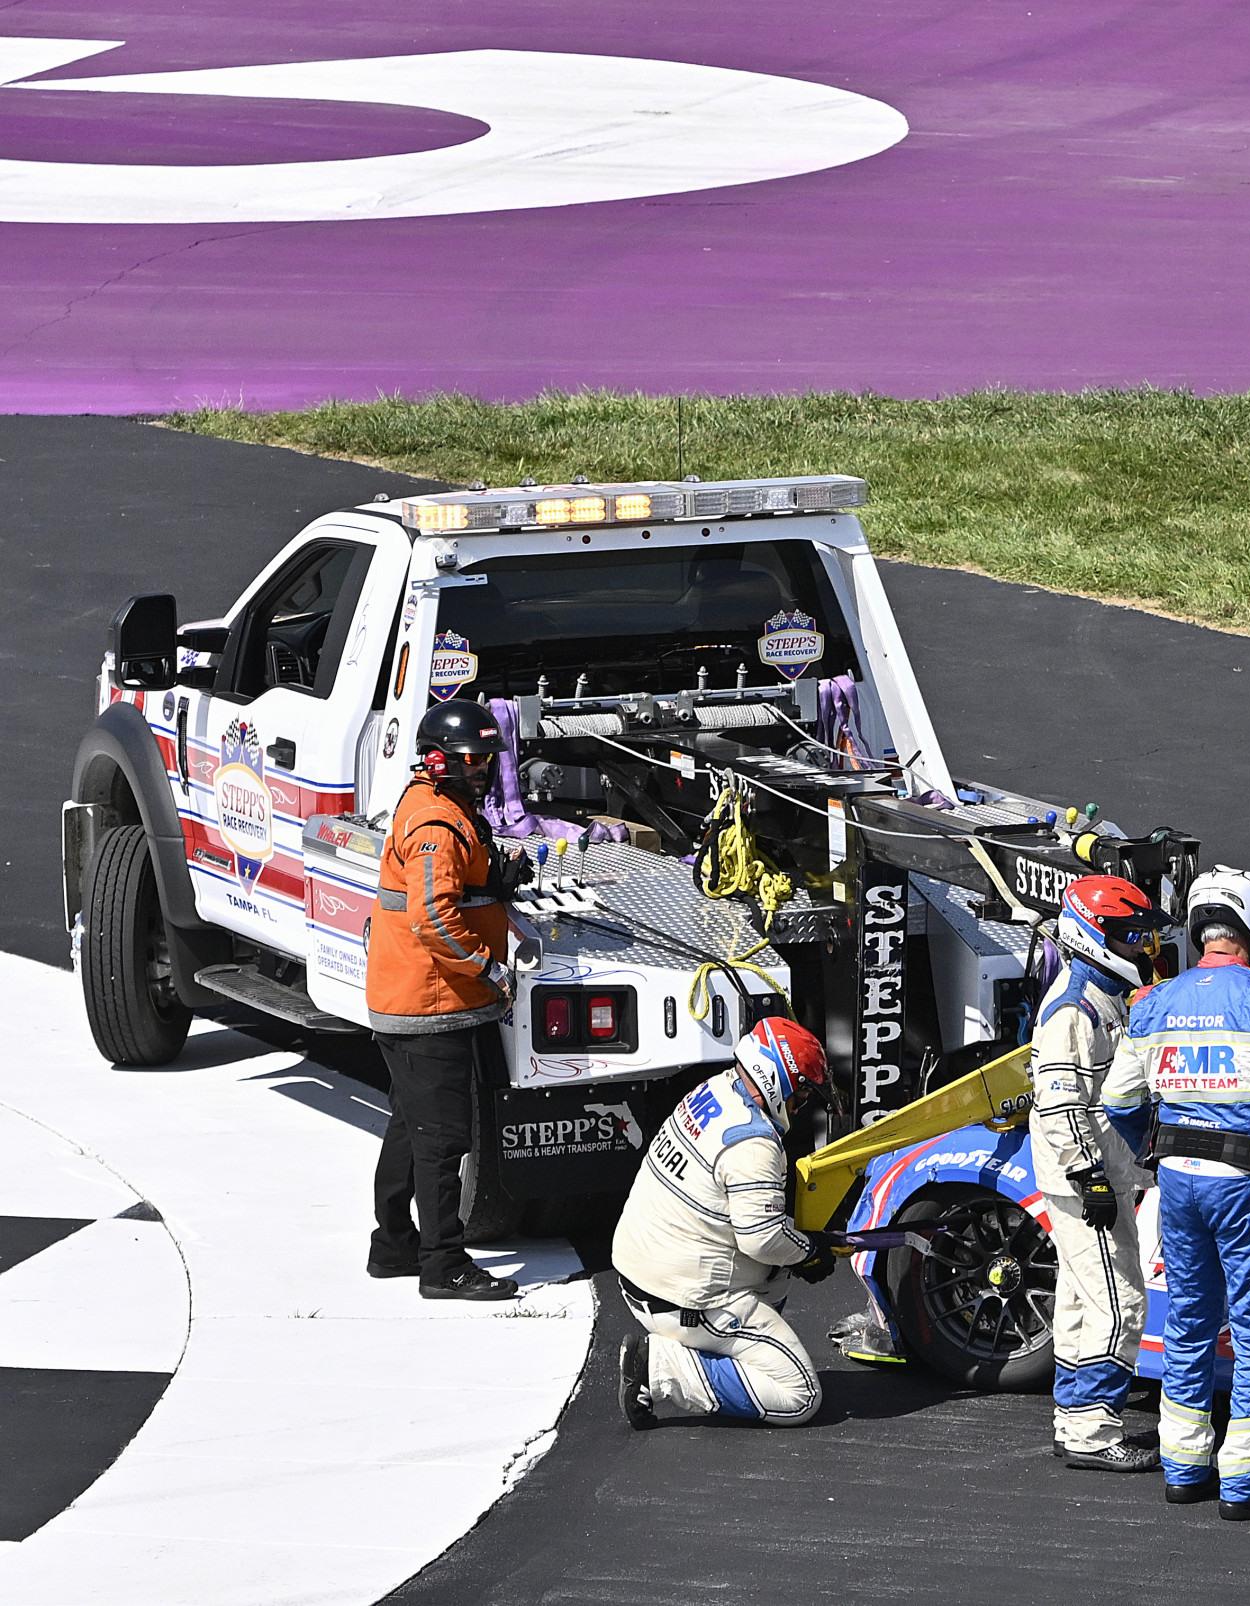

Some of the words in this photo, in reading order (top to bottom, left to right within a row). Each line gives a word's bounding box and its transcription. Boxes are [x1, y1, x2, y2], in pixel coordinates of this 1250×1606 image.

[766, 636, 817, 651] STEPP'S
[766, 650, 782, 658] RACE
[784, 648, 818, 656] RECOVERY
[431, 657, 470, 670] EPP'S
[435, 669, 471, 678] RECOVERY
[221, 781, 266, 822] STEPP'S
[222, 813, 238, 830] RACE
[238, 817, 268, 842] RECOVERY
[226, 893, 260, 915] TAMPA
[1071, 894, 1096, 920] NASCAR
[320, 943, 338, 958] FAMILY
[338, 951, 358, 964] OWNED
[358, 958, 368, 969] AN
[1061, 931, 1096, 958] OFFICIAL
[318, 956, 344, 973] OPERATED
[344, 966, 360, 979] SINCE
[1166, 1015, 1225, 1028] DOCTOR
[779, 1040, 801, 1075] NASCAR
[1157, 1045, 1236, 1074] AMR
[752, 1064, 777, 1102] OFFICIAL
[1155, 1078, 1198, 1089] SAFETY
[1202, 1078, 1238, 1089] TEAM
[687, 1082, 723, 1131] MR
[502, 1116, 614, 1148] STEPP'S
[682, 1114, 702, 1141] TEAM
[1189, 1118, 1221, 1129] IMPACT
[503, 1147, 533, 1160] TOWING
[534, 1147, 540, 1156] &
[541, 1145, 566, 1156] HEAVY
[567, 1141, 612, 1154] TRANSPORT
[652, 1126, 689, 1181] FICIAL
[914, 1149, 1028, 1183] GOODYEAR
